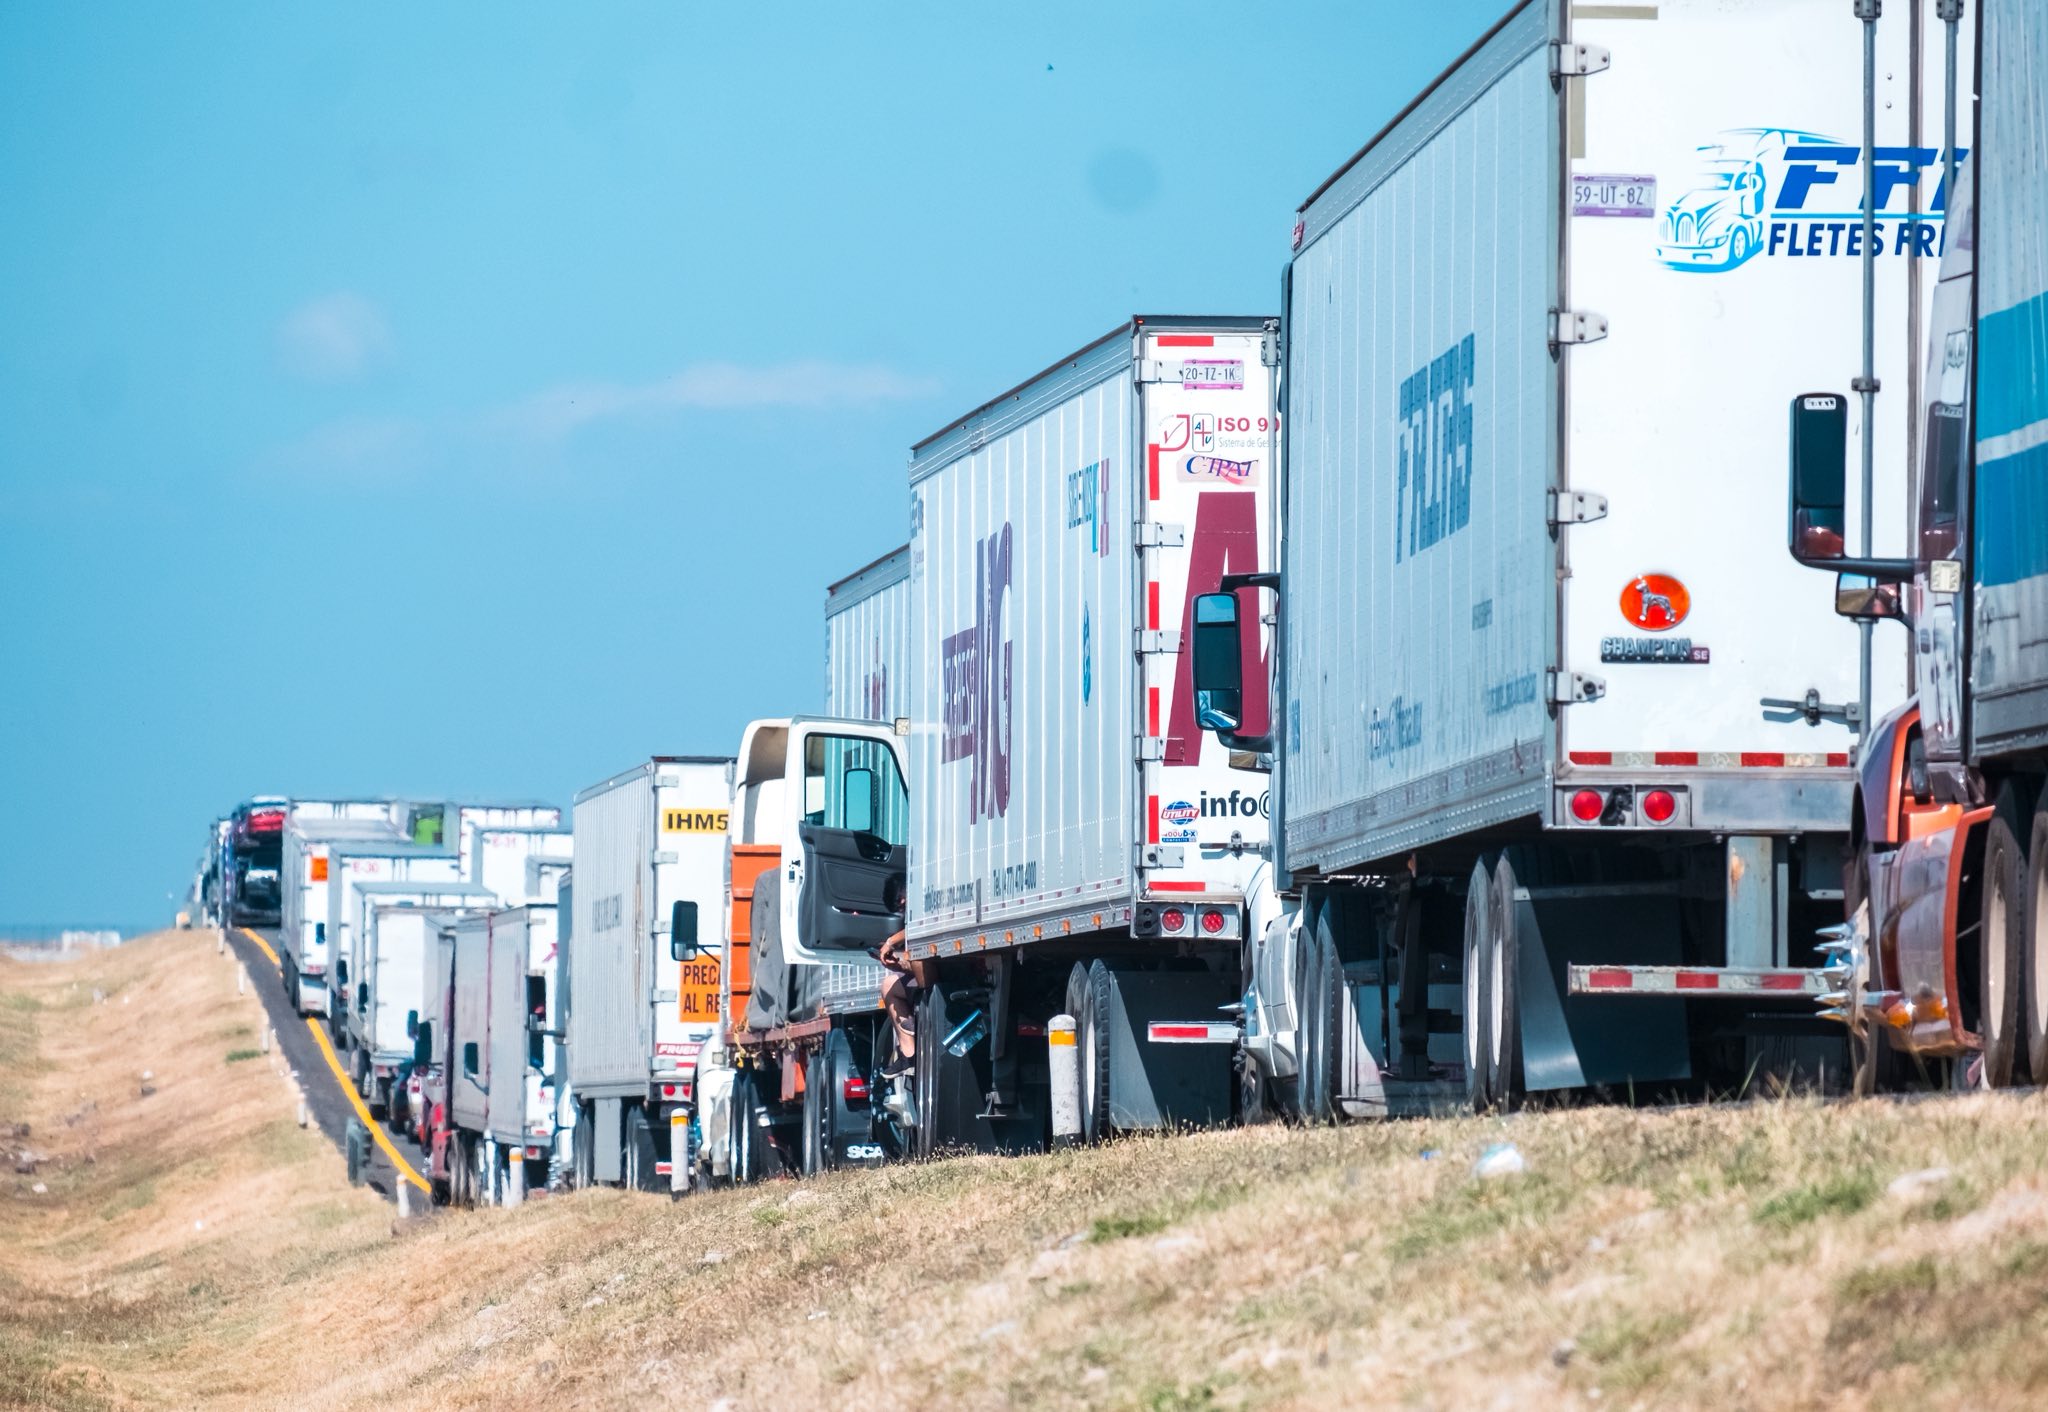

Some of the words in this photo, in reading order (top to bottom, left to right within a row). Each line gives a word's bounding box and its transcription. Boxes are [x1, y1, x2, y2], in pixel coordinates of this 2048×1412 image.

[1575, 186, 1643, 205] 59-UT-8Z
[1768, 223, 1885, 257] FLETES
[1185, 367, 1235, 381] 20-TZ-1K
[1217, 417, 1250, 432] ISO
[1219, 437, 1245, 448] Sistema
[1247, 437, 1256, 448] de
[1601, 638, 1691, 656] CHAMPION
[1694, 650, 1708, 660] SE
[668, 813, 729, 830] IHM5
[1163, 809, 1198, 819] UTILITY
[683, 993, 699, 1013] AL
[847, 1145, 884, 1159] SCA
